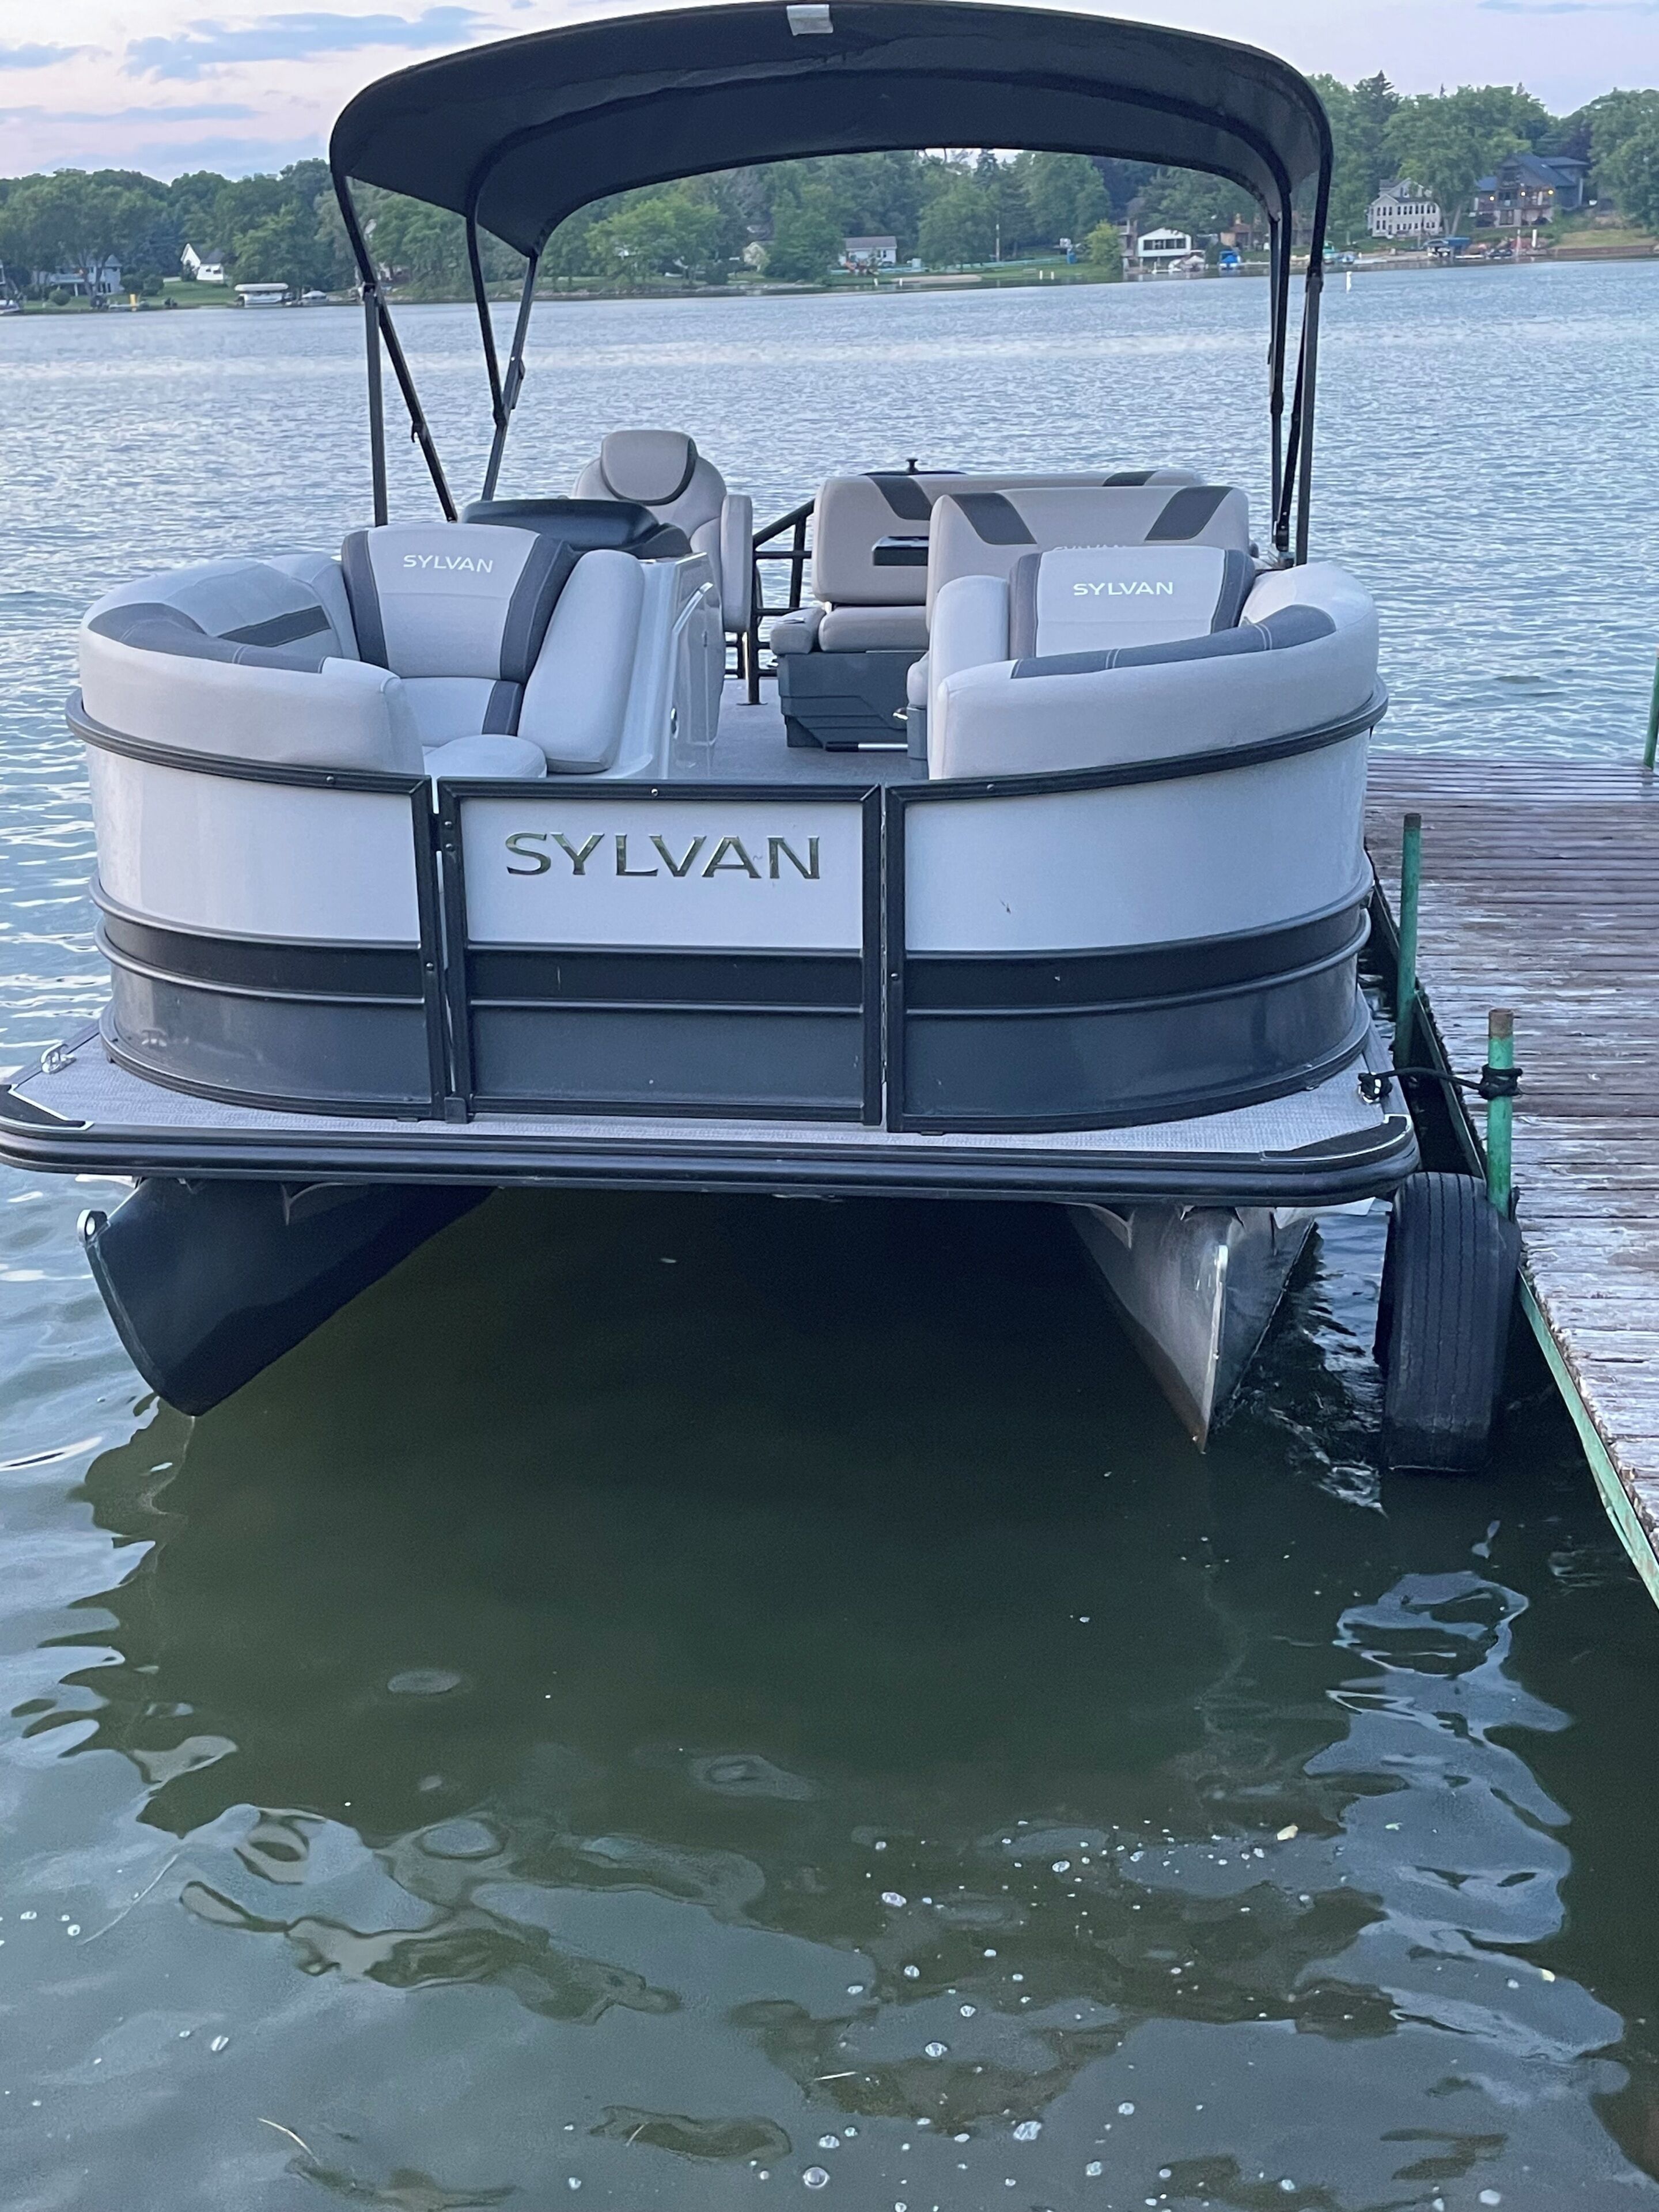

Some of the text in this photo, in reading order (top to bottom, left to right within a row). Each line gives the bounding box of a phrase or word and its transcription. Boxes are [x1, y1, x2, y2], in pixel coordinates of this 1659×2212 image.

[403, 555, 493, 573] SYLVAN
[1073, 582, 1173, 596] SYLVAN
[505, 832, 820, 879] SYLVAN
